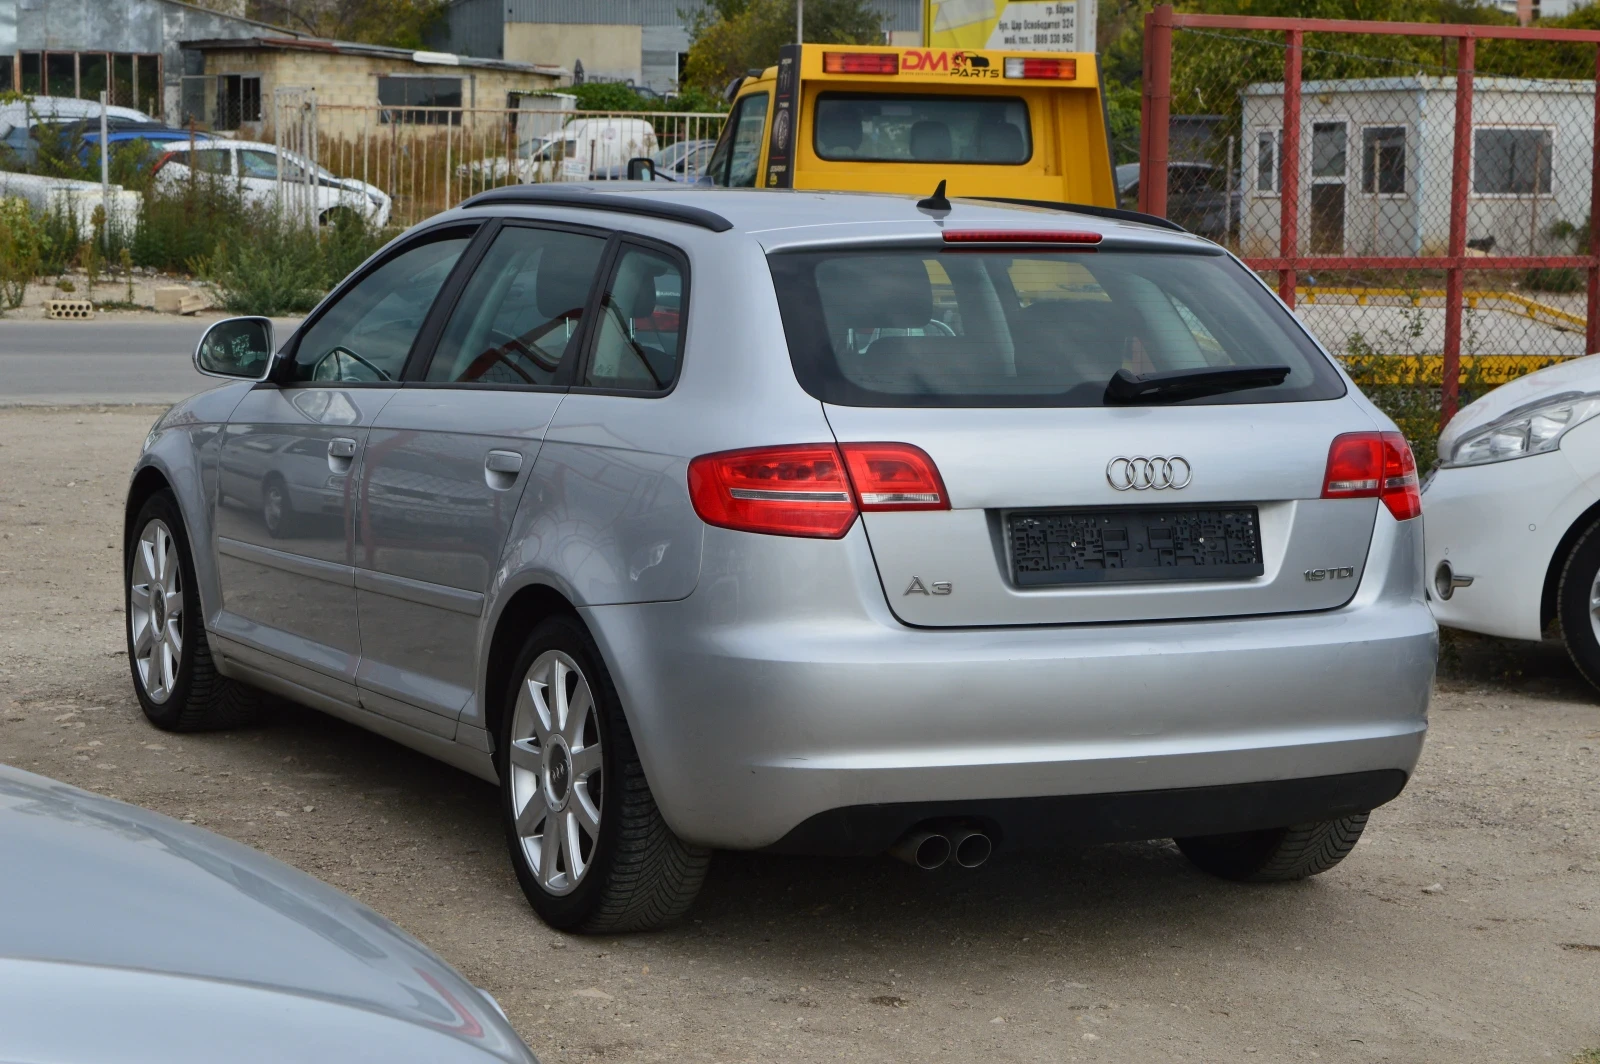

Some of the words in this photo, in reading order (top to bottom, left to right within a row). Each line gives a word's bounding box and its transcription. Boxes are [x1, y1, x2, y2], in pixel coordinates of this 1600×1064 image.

[1062, 18, 1073, 29] 324
[901, 50, 949, 71] DM
[950, 68, 999, 78] PARTS
[903, 575, 952, 596] A3
